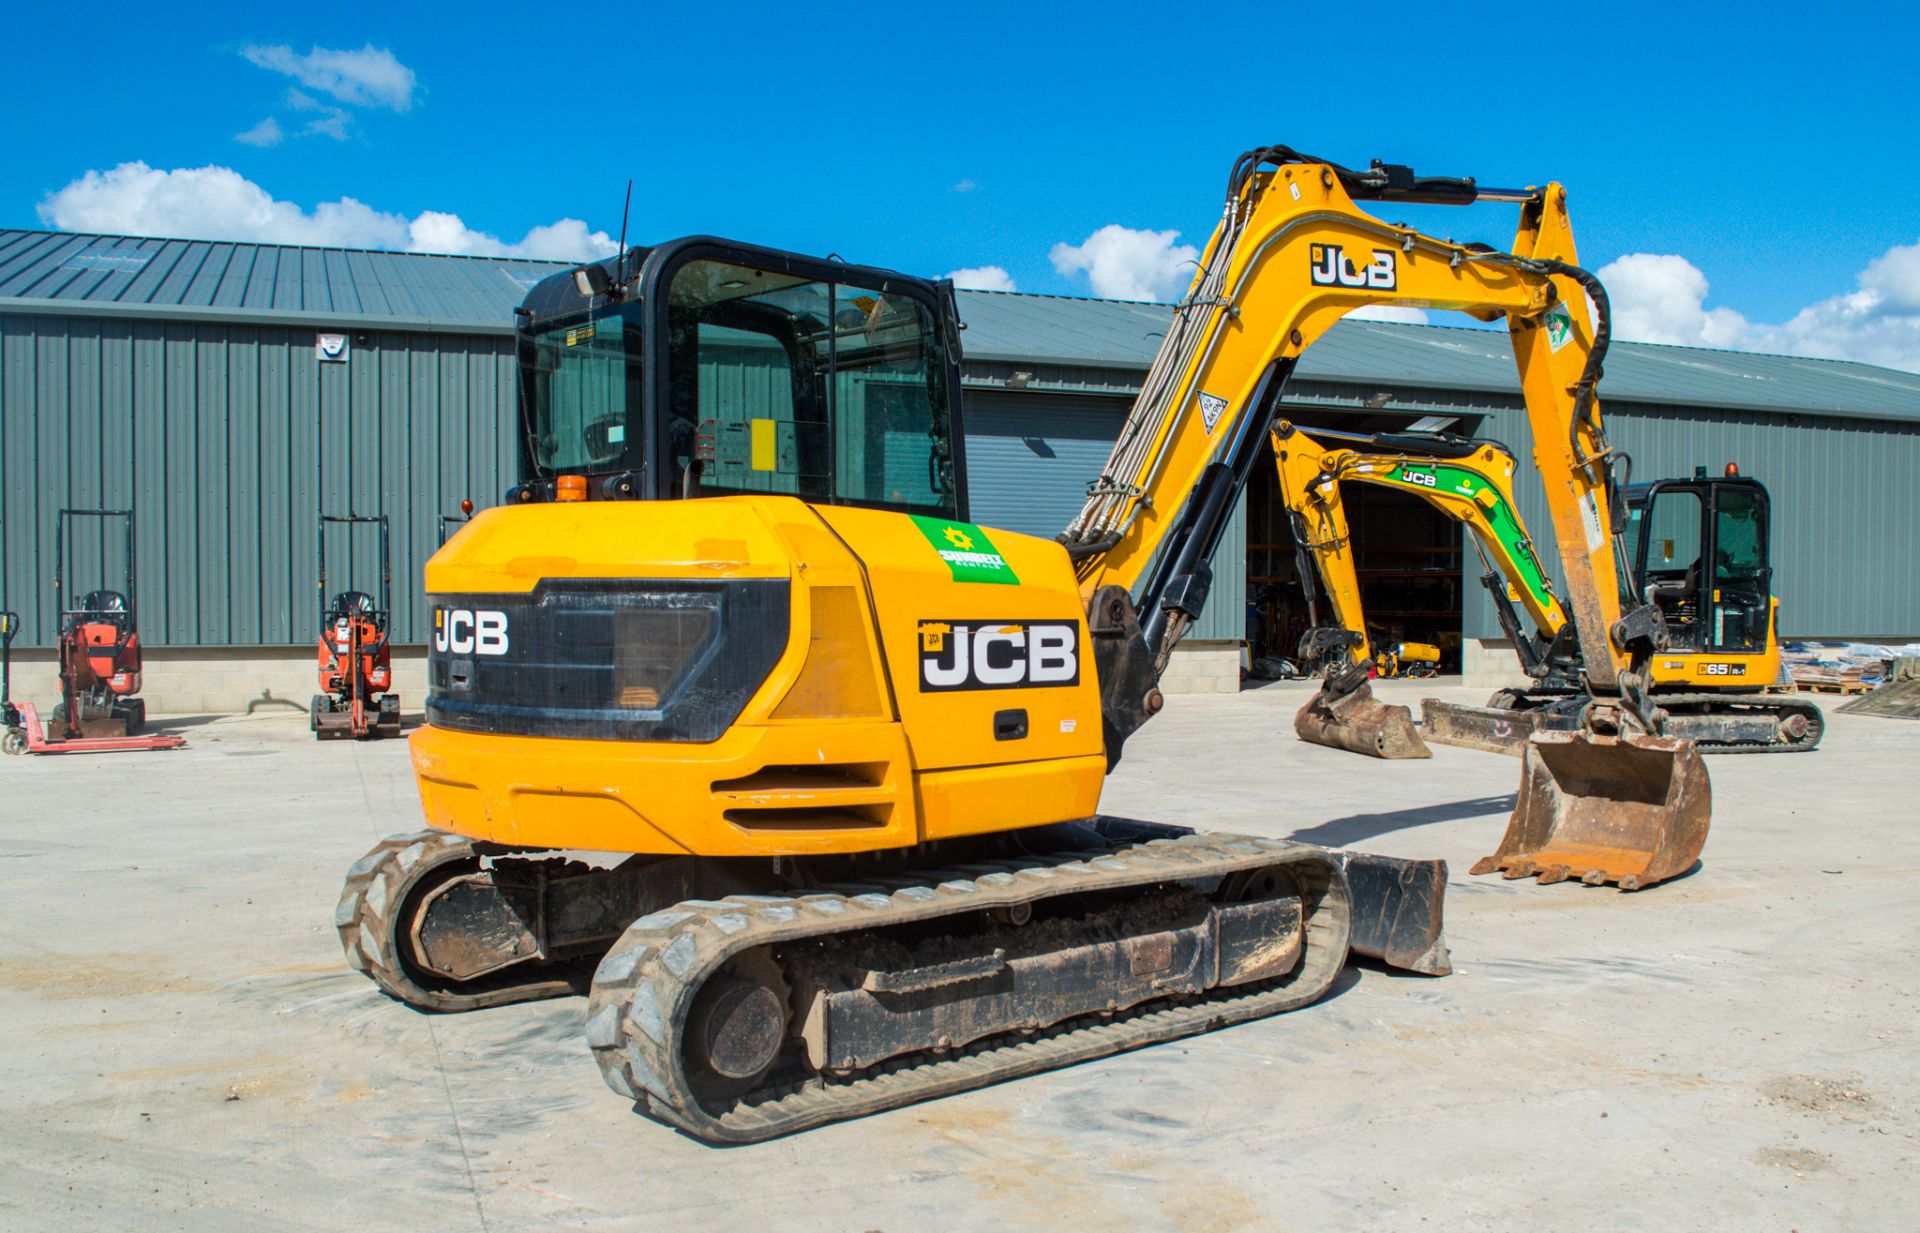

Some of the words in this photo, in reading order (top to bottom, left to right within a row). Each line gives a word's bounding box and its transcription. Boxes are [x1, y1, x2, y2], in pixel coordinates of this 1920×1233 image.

[1402, 471, 1437, 487] JCB
[938, 550, 1004, 566] SUNBELT
[435, 609, 509, 655] JCB
[924, 625, 1077, 686] JCB
[1707, 663, 1729, 675] 65
